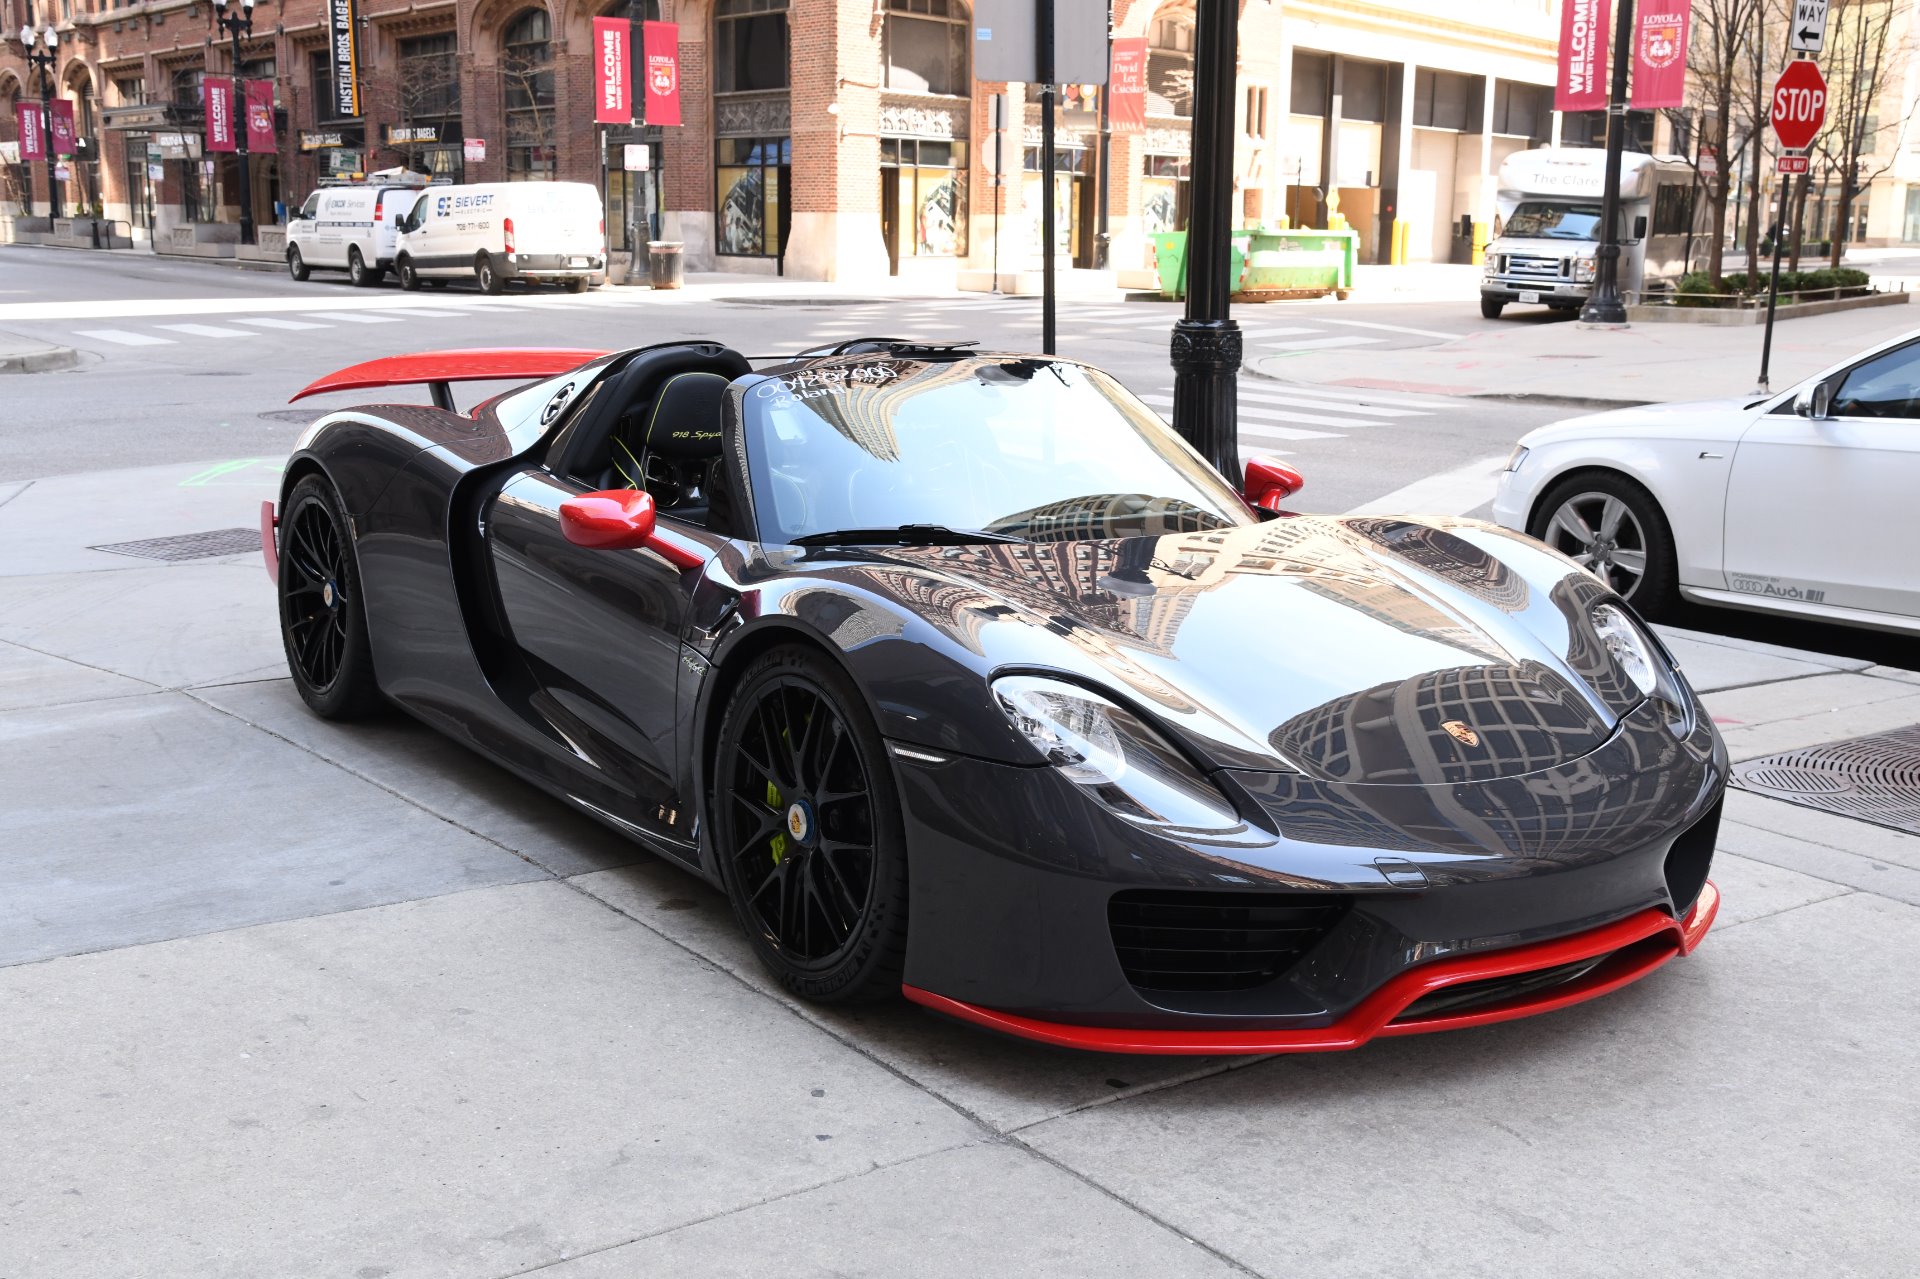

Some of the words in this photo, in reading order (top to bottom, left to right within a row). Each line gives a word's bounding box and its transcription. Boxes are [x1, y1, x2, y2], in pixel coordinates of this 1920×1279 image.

[1643, 13, 1682, 24] LOYOLA
[1799, 4, 1825, 23] WAY
[1587, 30, 1596, 62] TOWER
[649, 55, 675, 63] LOYOLA
[604, 30, 616, 110] WELCOME
[1114, 62, 1138, 73] David
[1123, 73, 1137, 83] Lee
[340, 64, 354, 114] EINSTEIN
[1774, 87, 1824, 121] STOP
[212, 87, 223, 142] WELCOME
[23, 110, 34, 153] WELCOME
[417, 127, 436, 138] BAGELS
[1779, 160, 1791, 170] ALL
[1792, 160, 1805, 171] WAY
[1533, 173, 1558, 185] The
[1562, 174, 1600, 187] Clare
[455, 194, 494, 208] SIEVERT
[672, 430, 690, 438] 918
[1732, 572, 1769, 582] POWERED
[1763, 583, 1803, 599] Audi
